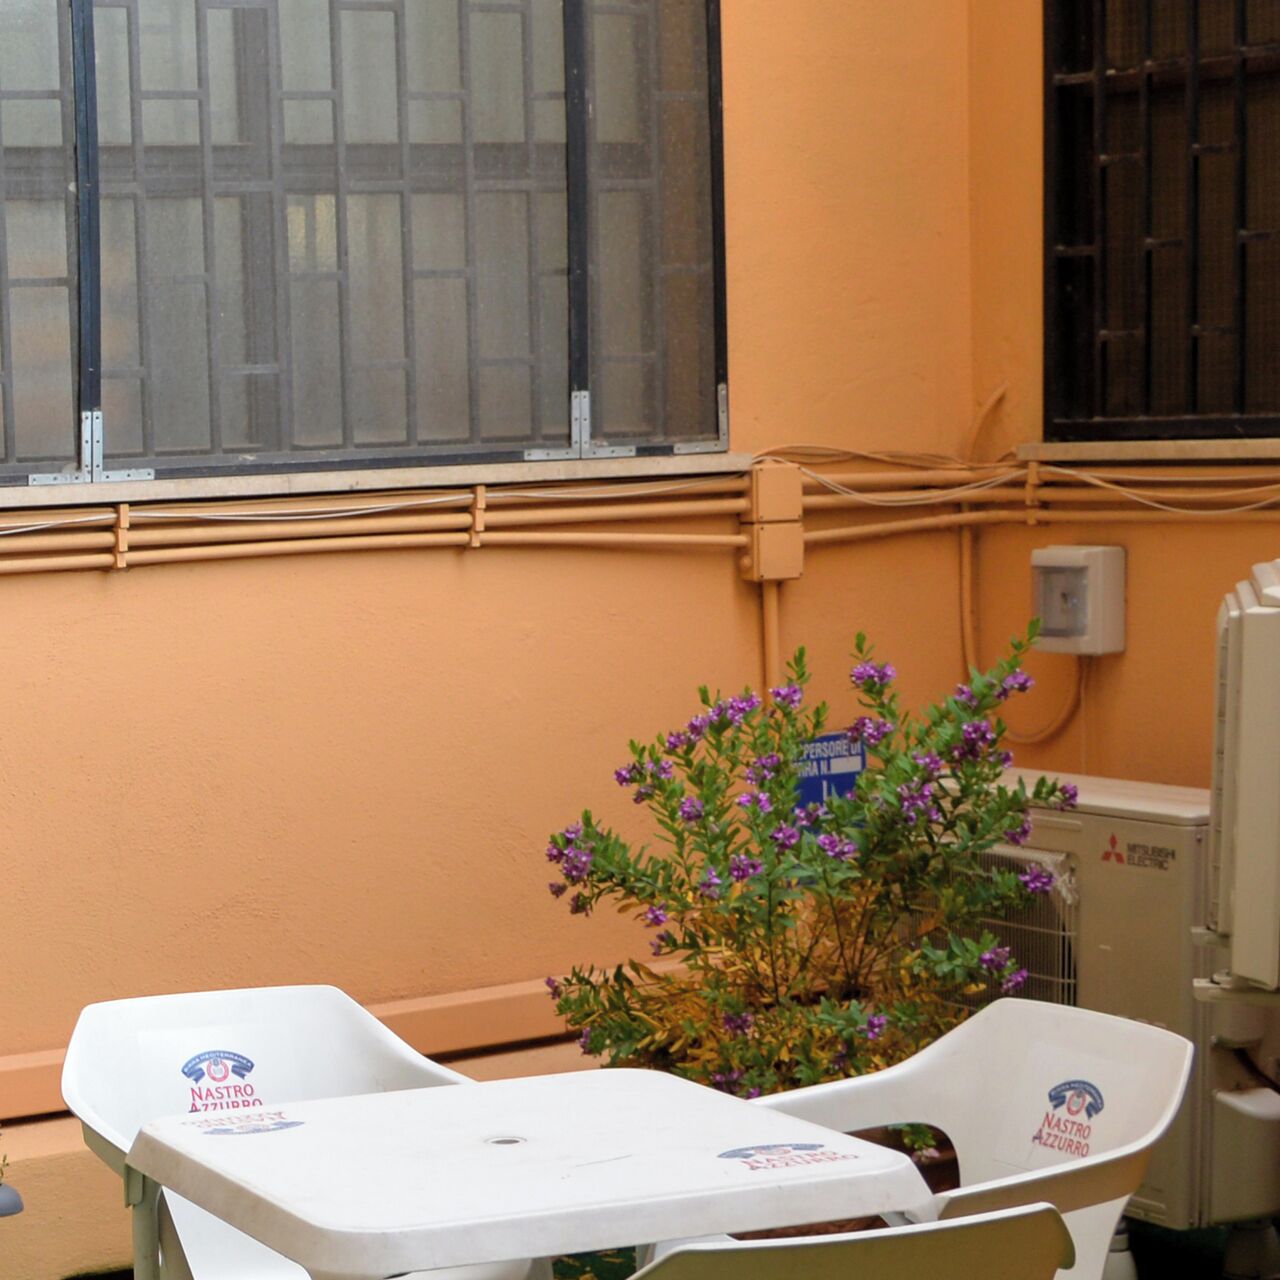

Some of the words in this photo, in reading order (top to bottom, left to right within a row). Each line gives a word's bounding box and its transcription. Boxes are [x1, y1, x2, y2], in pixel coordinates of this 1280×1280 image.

[190, 1084, 254, 1102] NASTRO
[1042, 1112, 1092, 1140] NASTRO
[1032, 1127, 1090, 1158] AZZURRO
